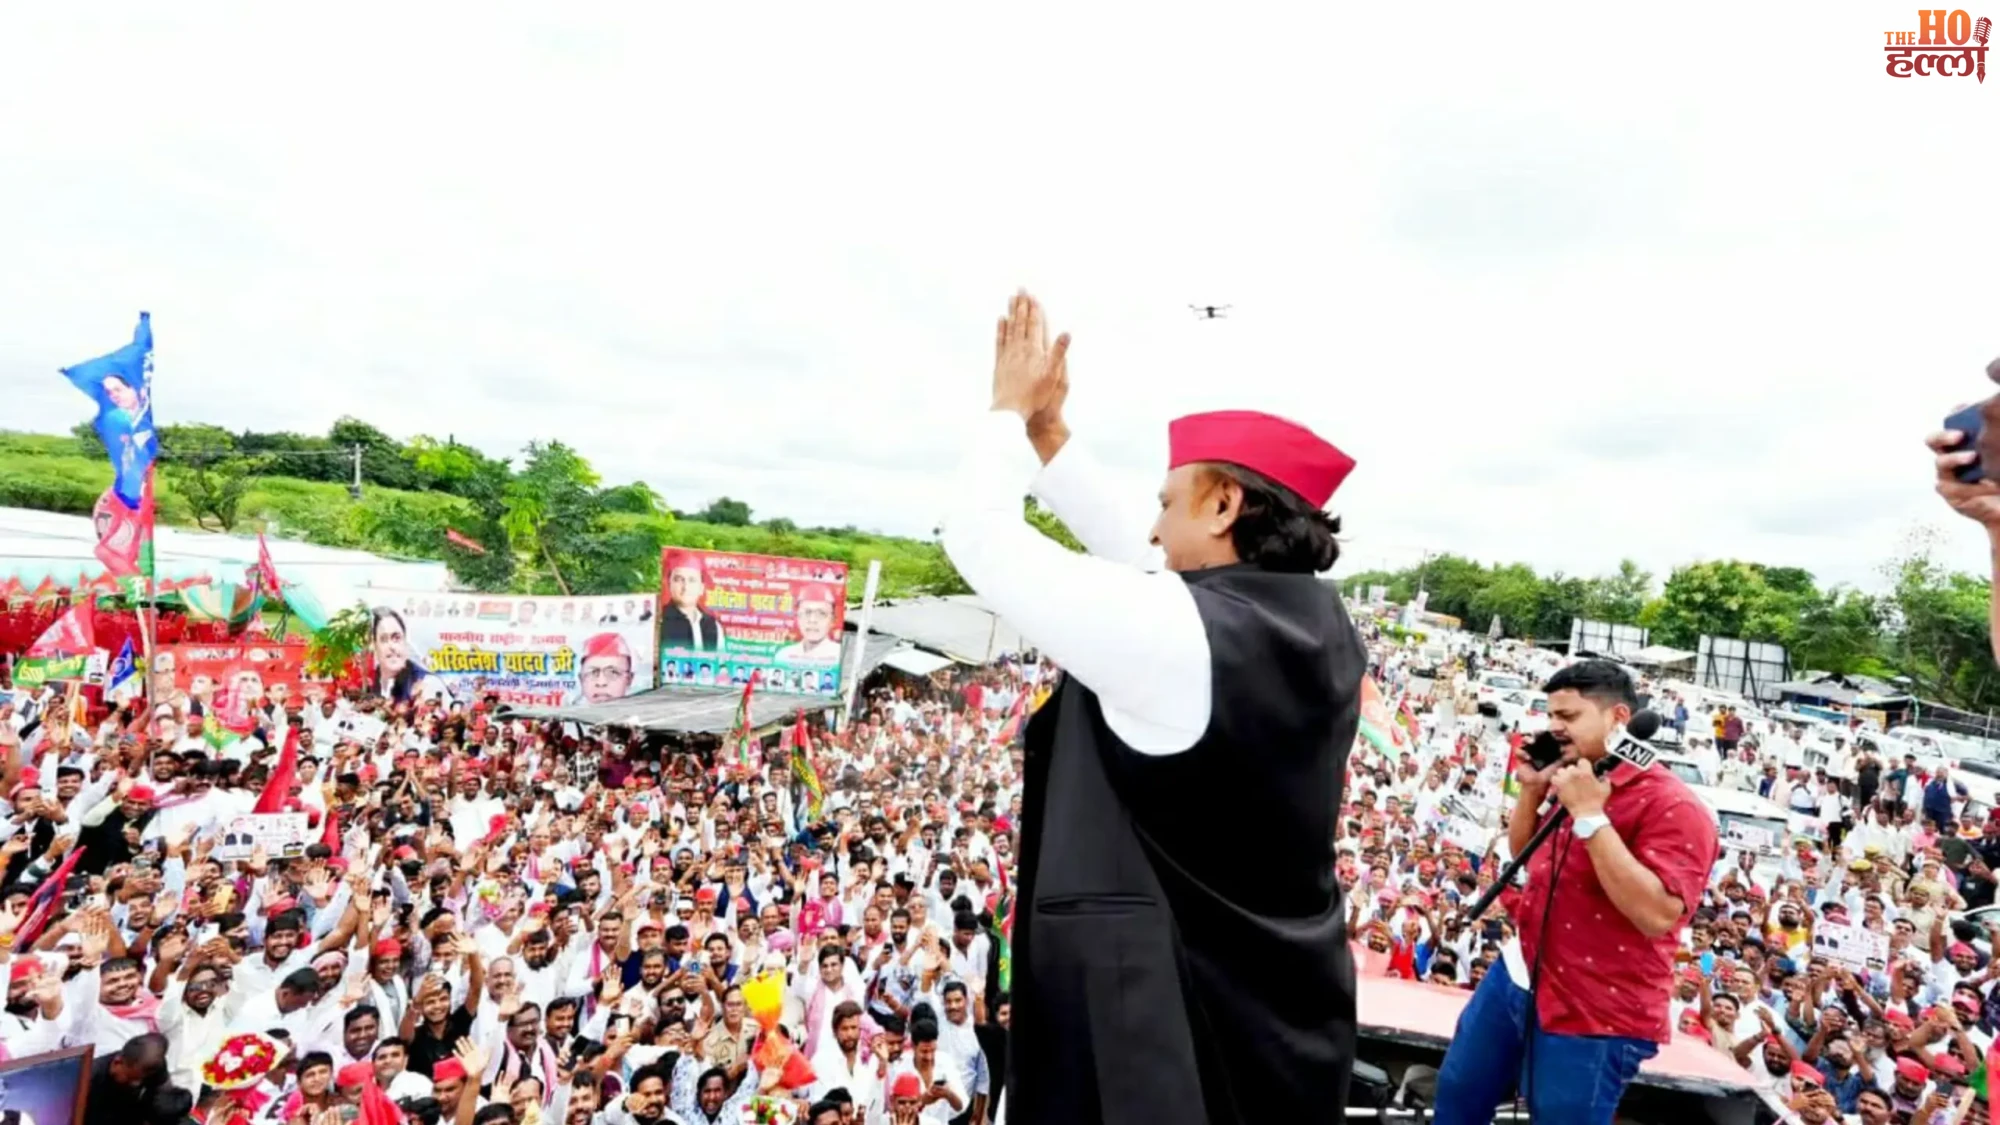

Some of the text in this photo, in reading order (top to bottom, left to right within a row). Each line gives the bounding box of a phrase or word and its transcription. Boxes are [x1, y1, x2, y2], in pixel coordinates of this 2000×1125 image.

[428, 644, 576, 674] अखिलेश यादव जी
[1616, 741, 1653, 766] ANI
